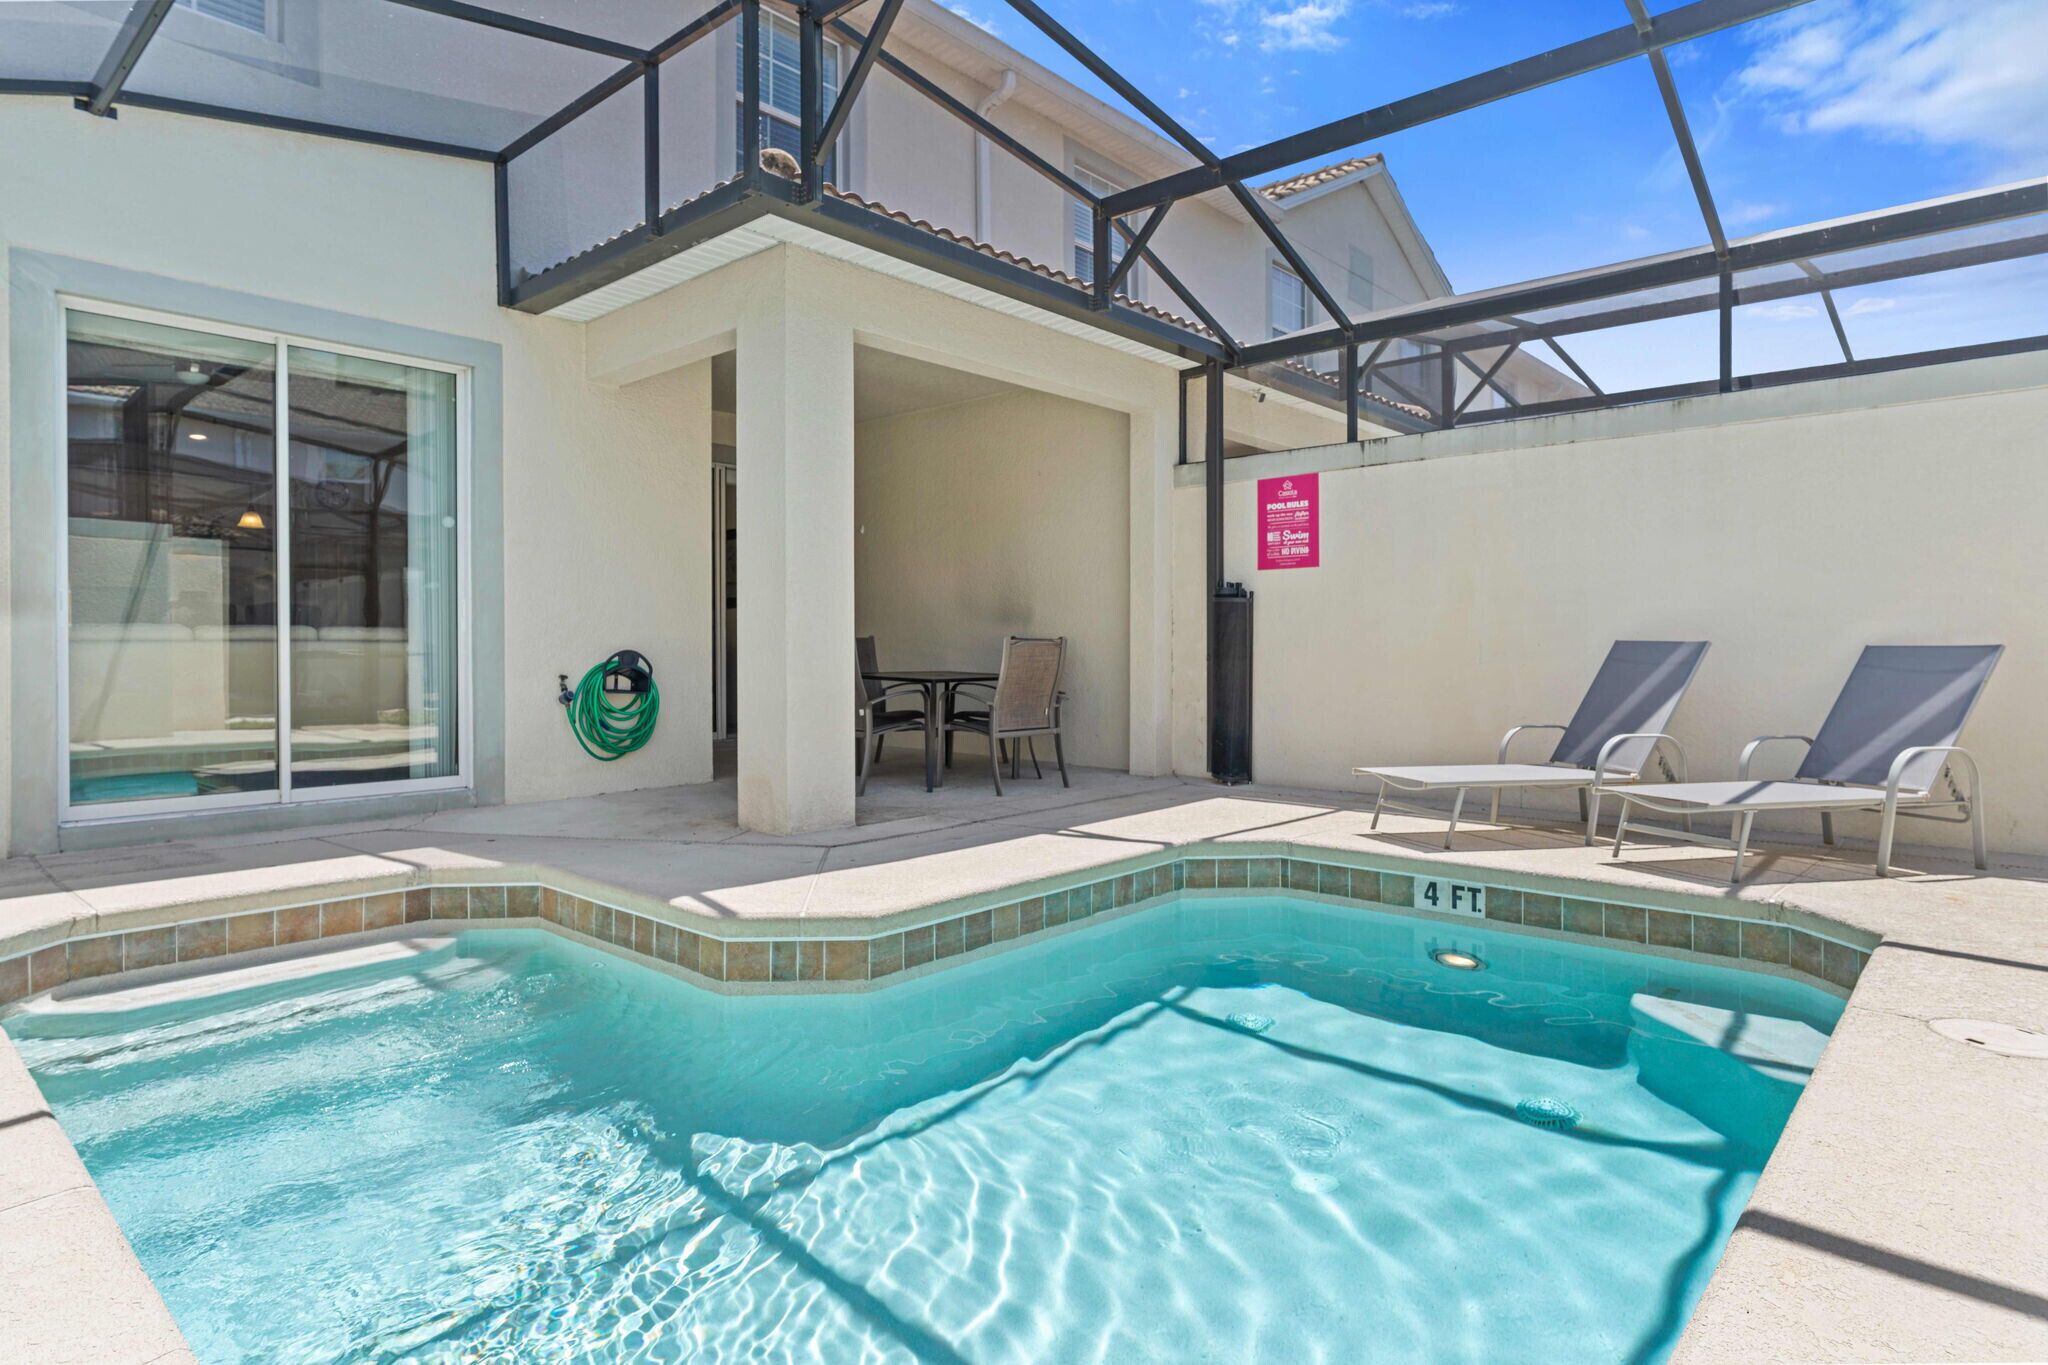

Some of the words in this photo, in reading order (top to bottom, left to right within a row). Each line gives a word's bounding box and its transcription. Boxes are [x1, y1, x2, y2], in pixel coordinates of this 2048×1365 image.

[1282, 530, 1309, 540] Swim
[1424, 881, 1439, 906] 4
[1451, 884, 1482, 913] FT.
